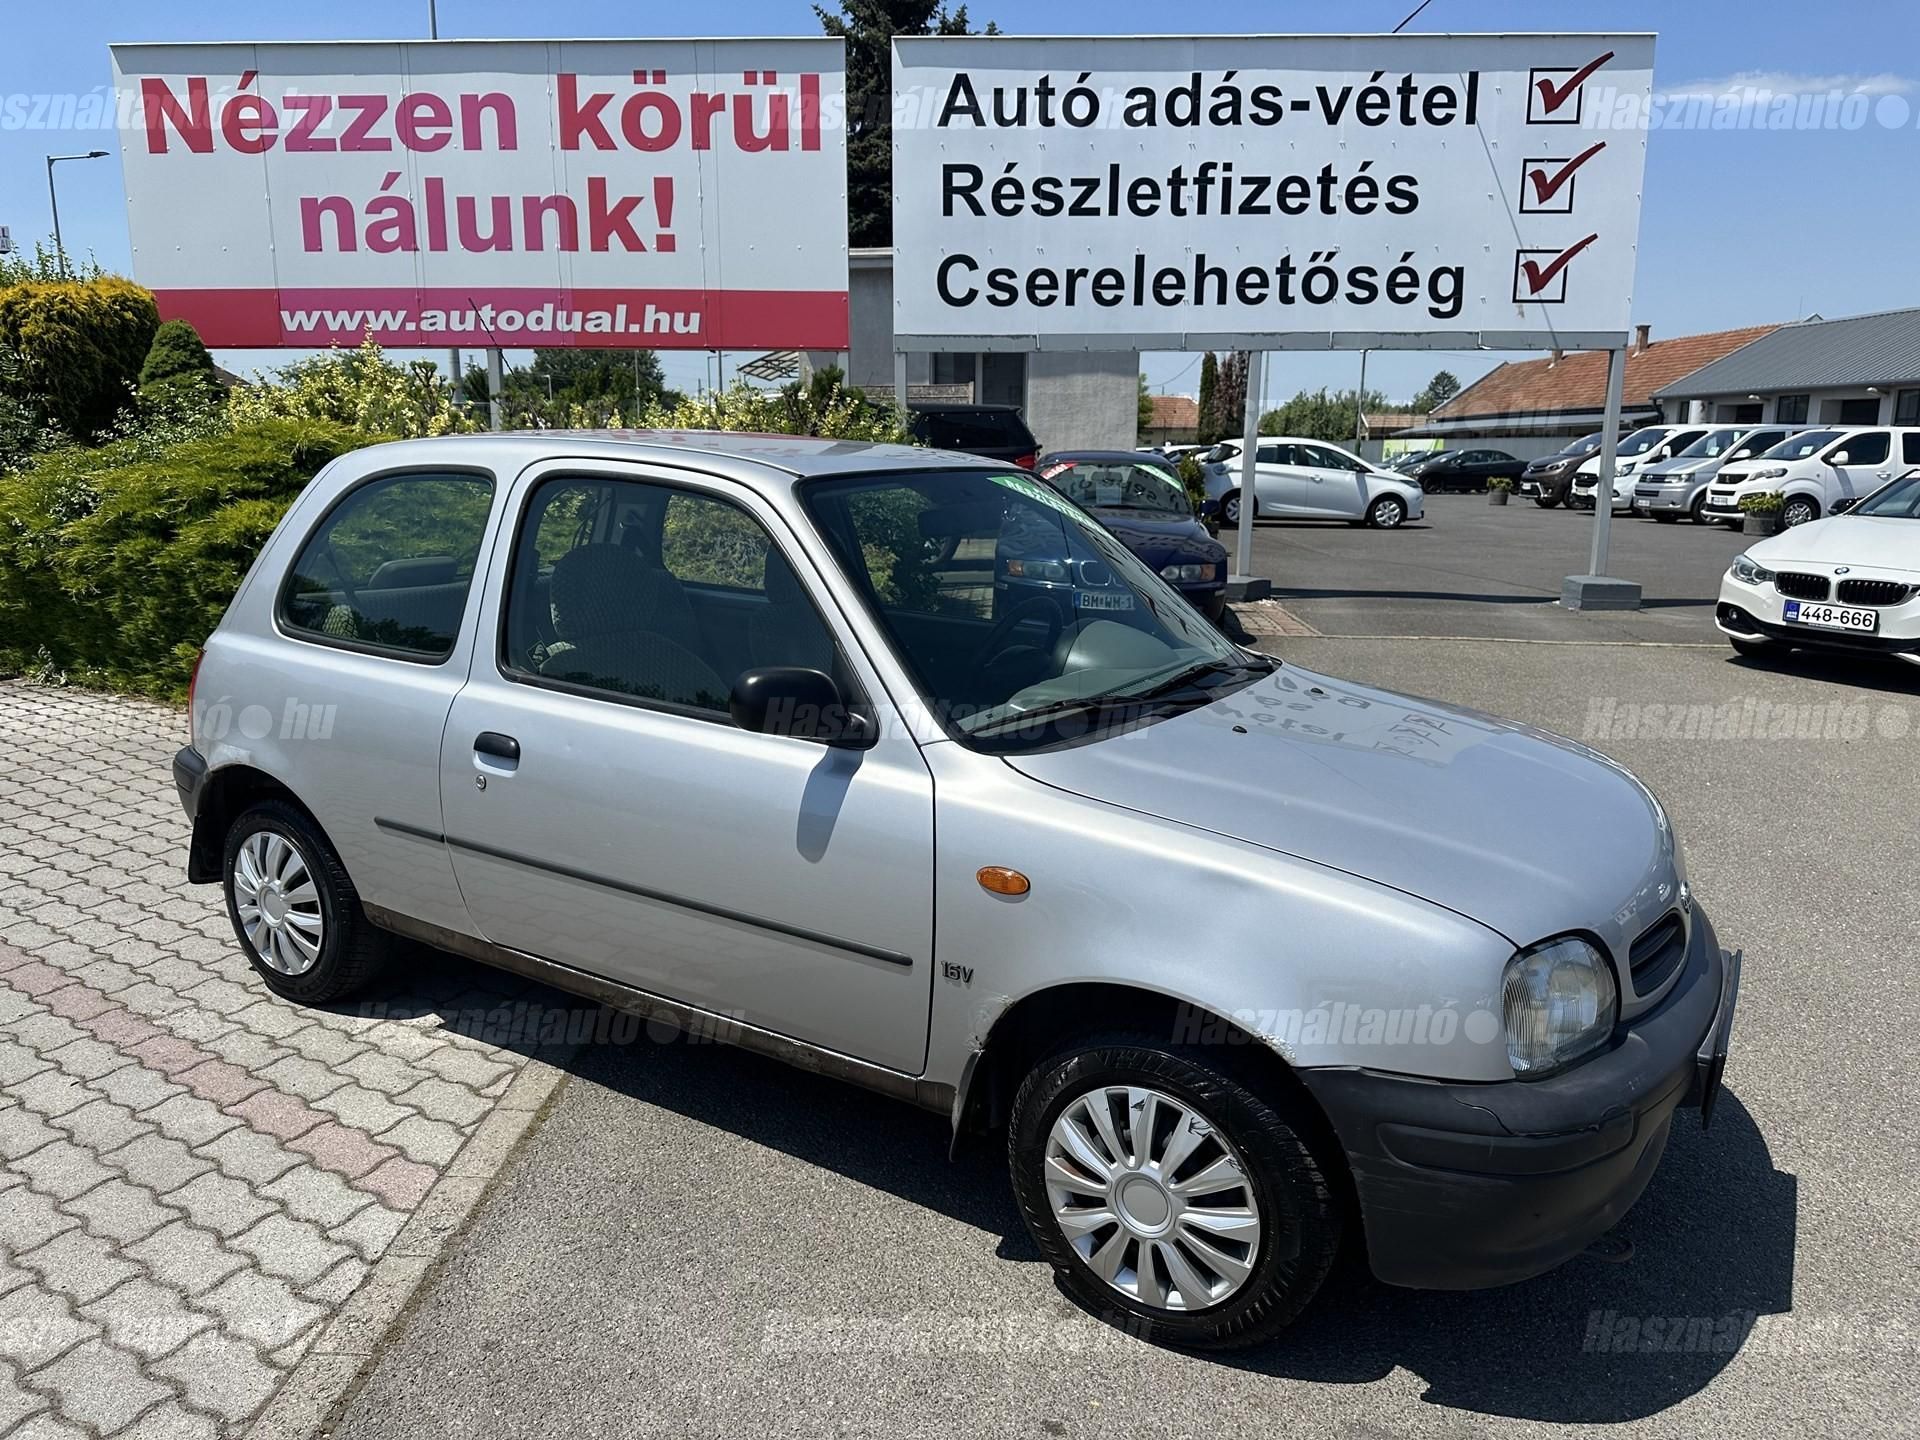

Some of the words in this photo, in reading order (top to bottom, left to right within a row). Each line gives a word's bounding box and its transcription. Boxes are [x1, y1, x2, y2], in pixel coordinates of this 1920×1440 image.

[141, 71, 517, 153] Nézzen
[558, 71, 821, 153] körül
[937, 72, 1101, 128] Autó
[1123, 70, 1479, 128] adás-vétel
[301, 173, 676, 253] nálunk!
[942, 160, 1419, 217] Részletfizetés
[937, 252, 1465, 319] Cserelehetőség
[280, 303, 700, 334] www.autodual.hu
[1800, 606, 1873, 628] 448-666
[941, 960, 974, 983] 16V
